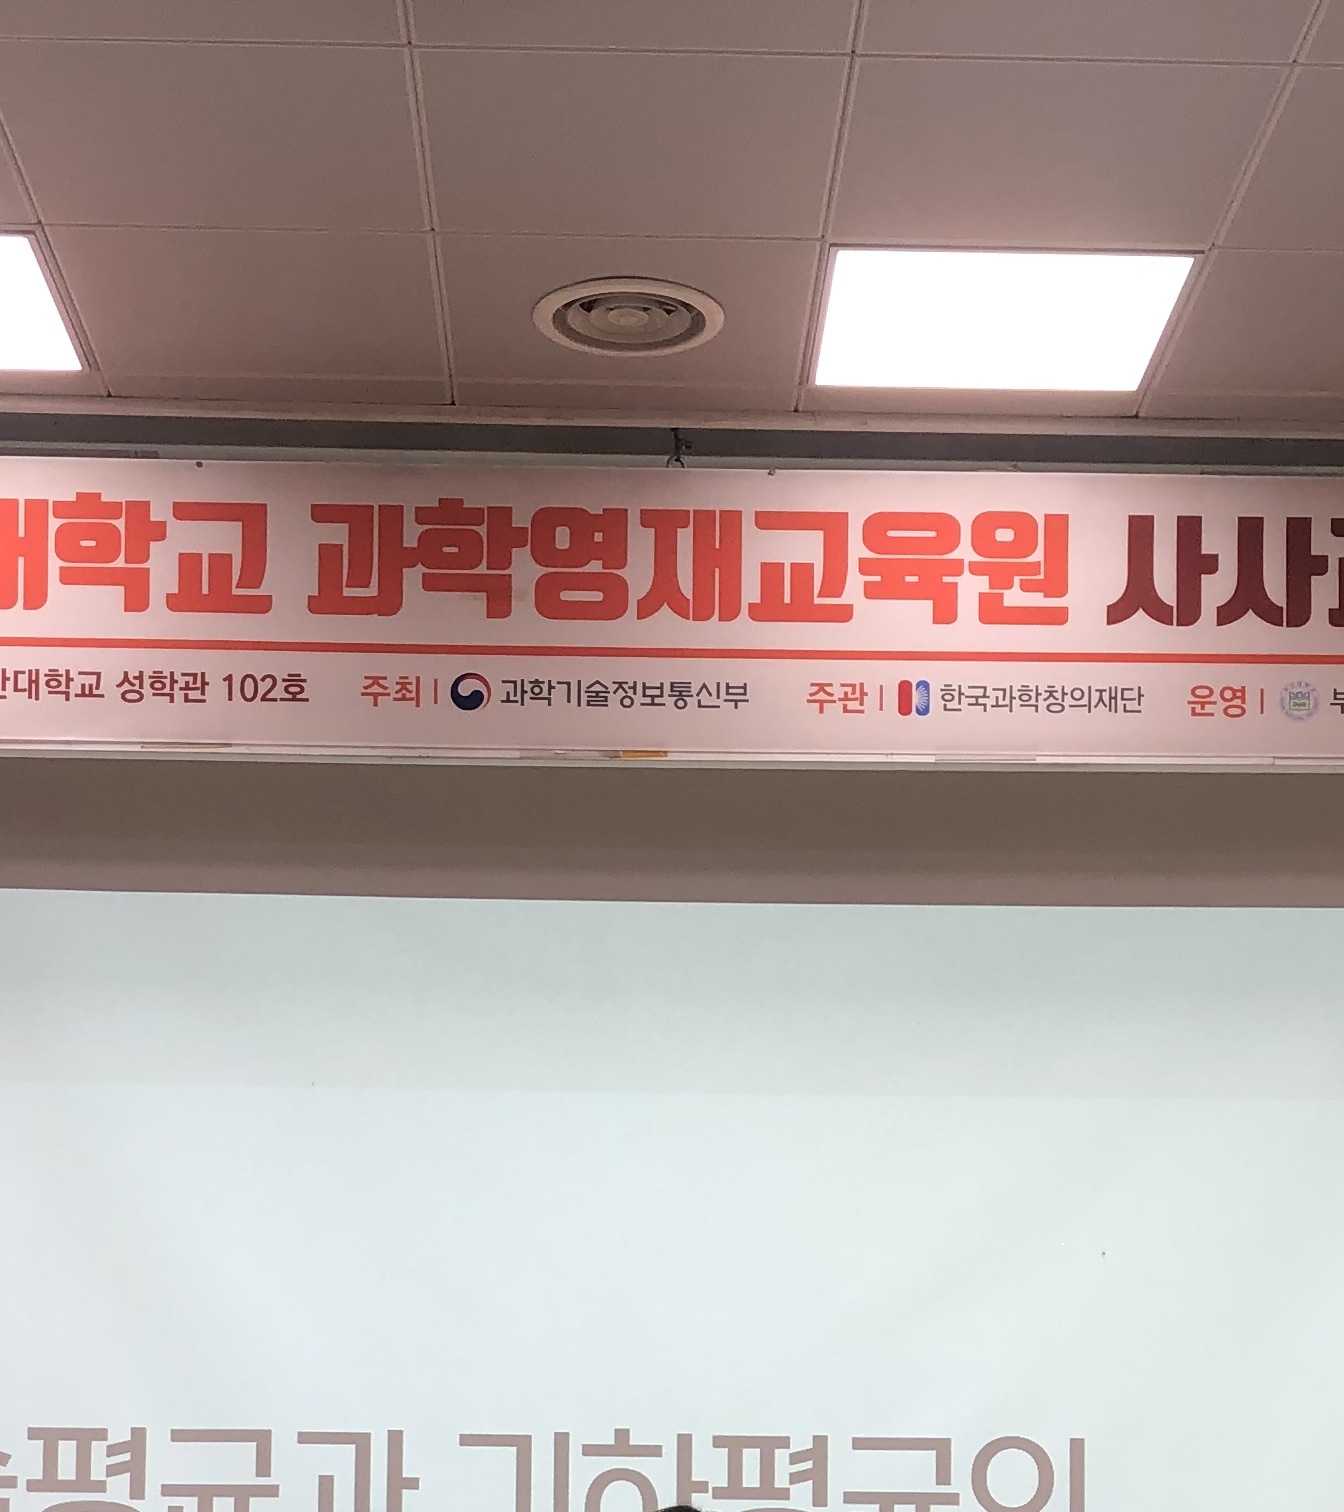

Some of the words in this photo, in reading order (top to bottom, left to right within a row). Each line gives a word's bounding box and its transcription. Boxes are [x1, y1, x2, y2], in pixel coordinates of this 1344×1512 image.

[306, 497, 1071, 626] 과학영재교육원
[115, 670, 210, 704] 성학관
[222, 673, 310, 703] 102호
[360, 675, 421, 708] 주최
[499, 678, 750, 710] 과학기술정보통신부
[806, 681, 869, 715] 주관
[939, 683, 1145, 714] 한국과학창의재단
[1187, 684, 1247, 719] 운영
